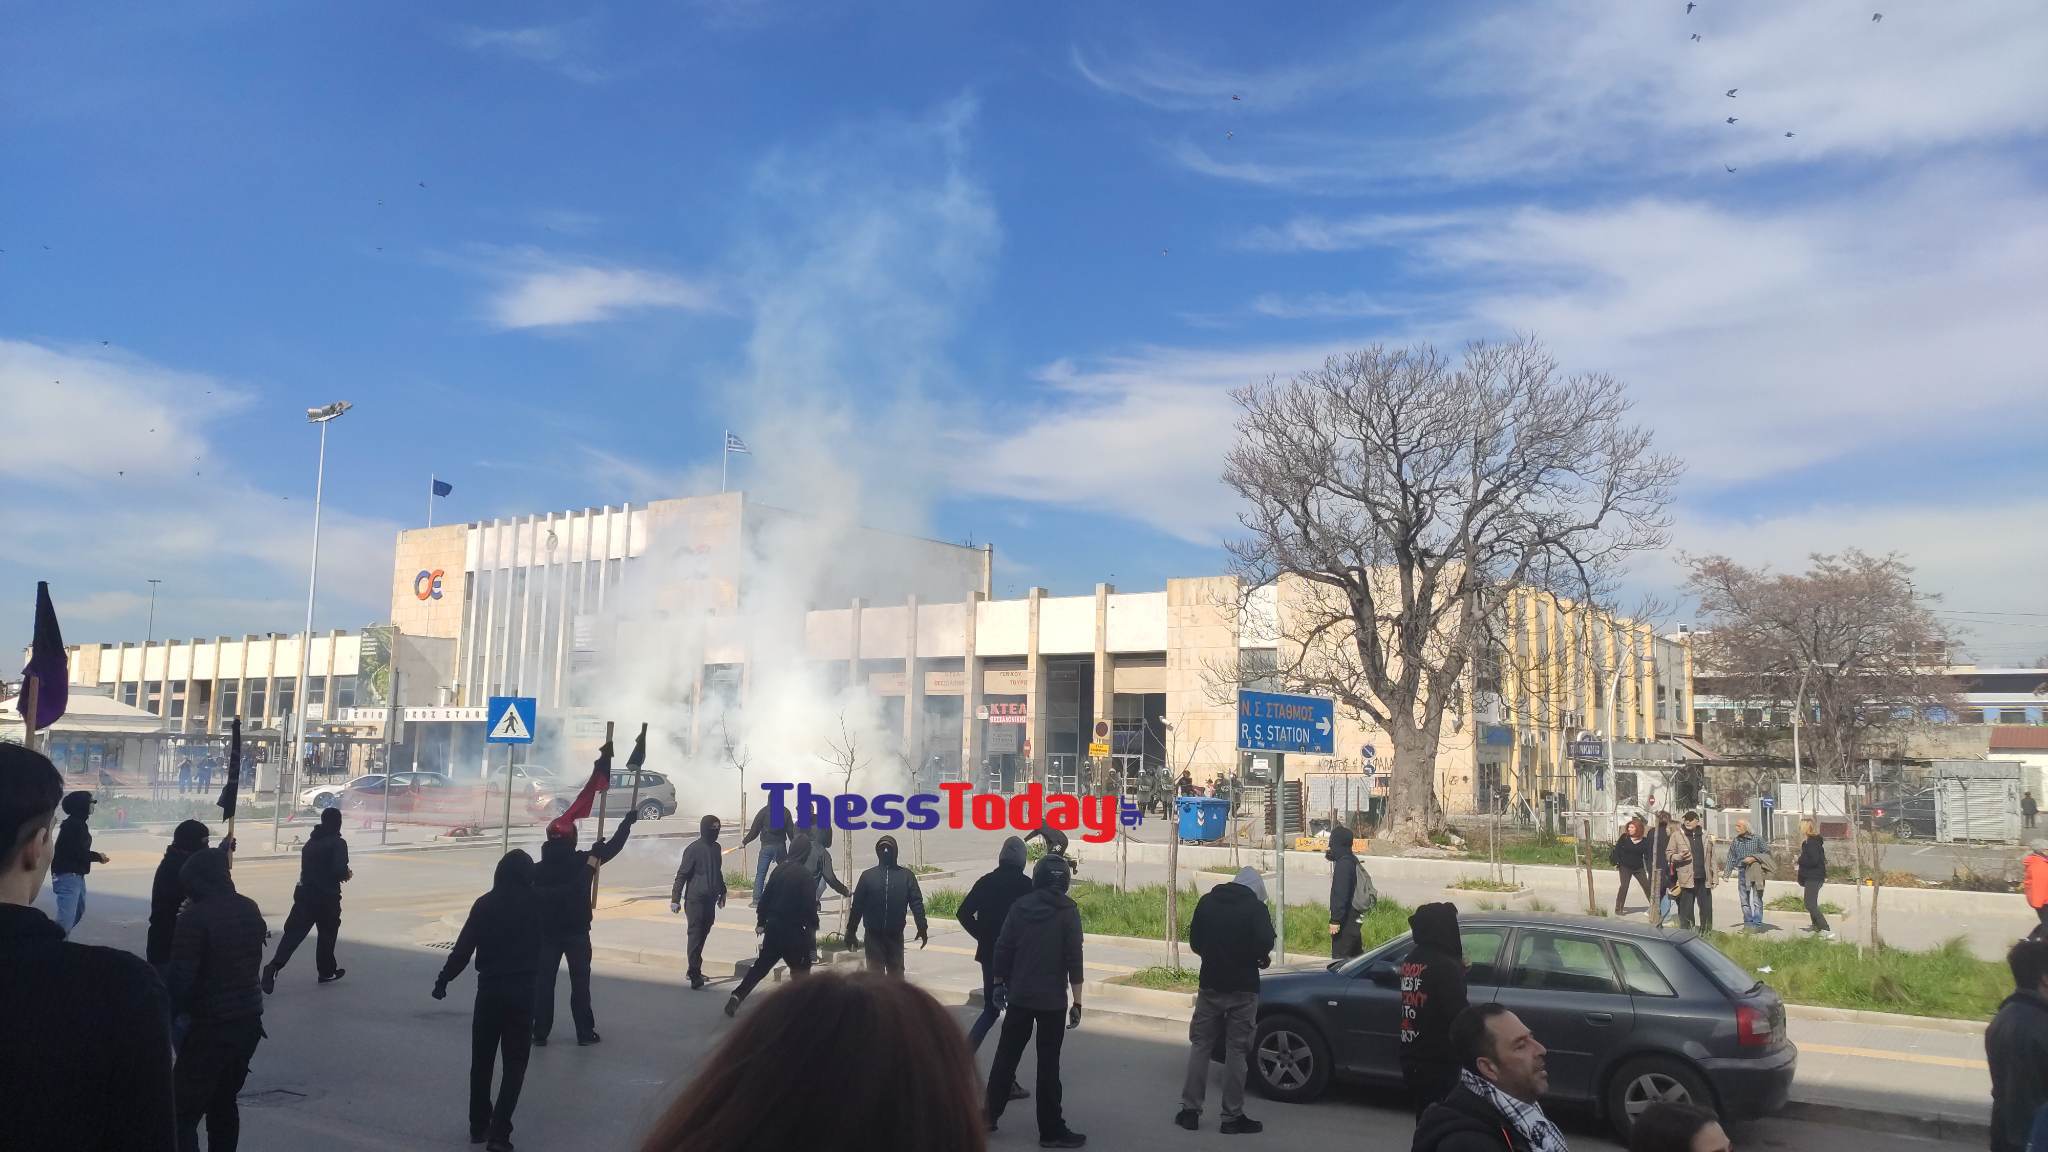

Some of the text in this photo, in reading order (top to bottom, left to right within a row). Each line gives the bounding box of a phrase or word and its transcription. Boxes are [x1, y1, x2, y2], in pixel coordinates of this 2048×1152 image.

[990, 703, 1027, 715] ΚΤΕΛ
[1266, 702, 1315, 721] ΣΤΑΘΜΟΣ
[1267, 725, 1310, 744] STATION
[1405, 1005, 1417, 1019] TO
